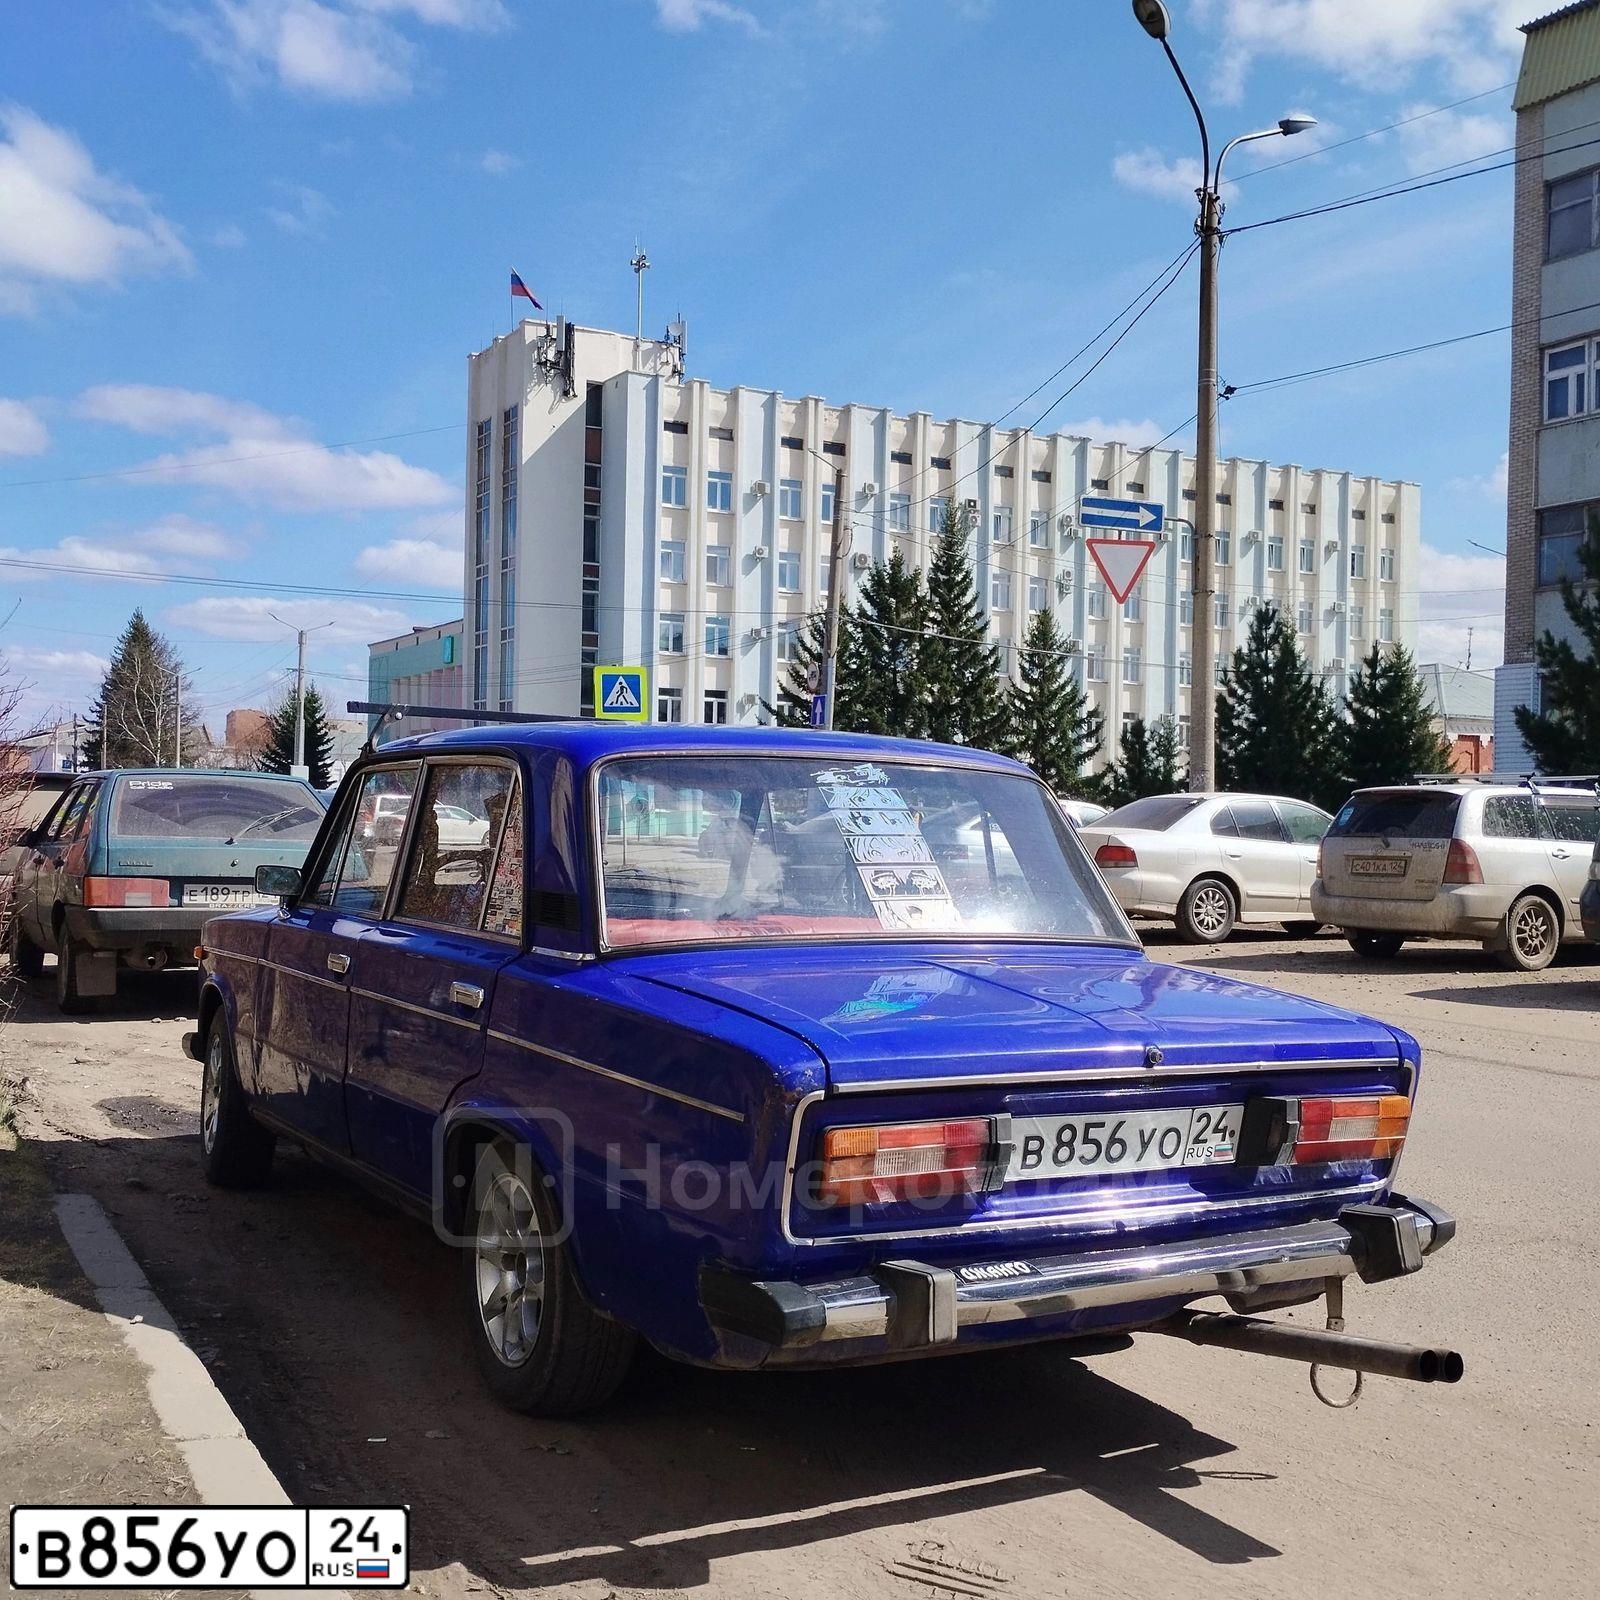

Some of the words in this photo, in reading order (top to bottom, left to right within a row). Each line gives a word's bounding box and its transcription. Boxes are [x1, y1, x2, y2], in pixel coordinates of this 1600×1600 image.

[129, 780, 173, 788] Pride
[1020, 1120, 1182, 1170] В856УО
[1192, 1110, 1229, 1145] 24
[1186, 1146, 1214, 1159] RUS
